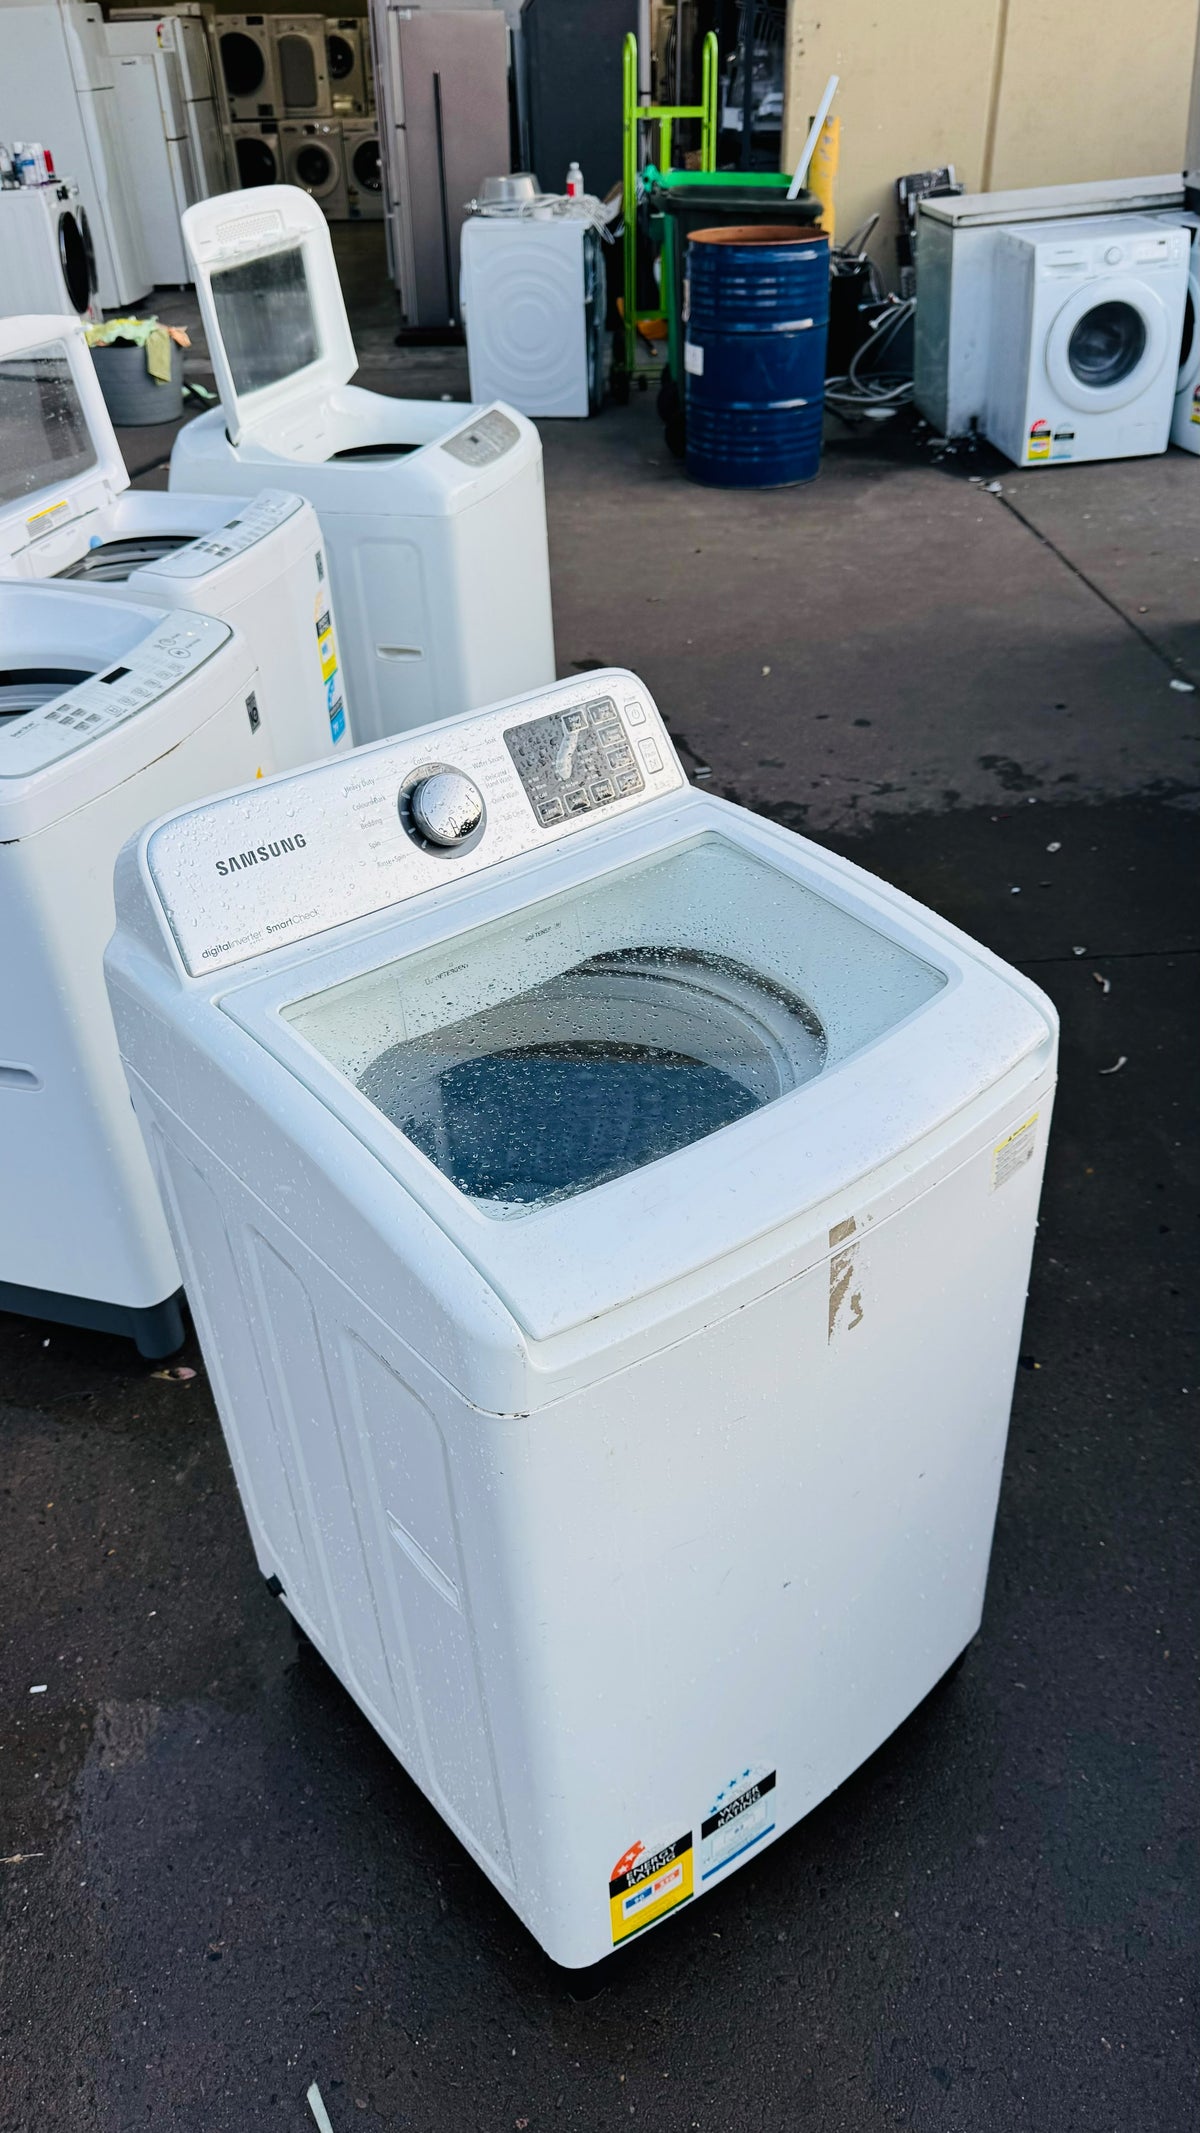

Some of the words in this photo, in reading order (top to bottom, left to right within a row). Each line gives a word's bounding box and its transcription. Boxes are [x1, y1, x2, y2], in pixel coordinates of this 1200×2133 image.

[360, 817, 383, 830] Bedding
[215, 833, 307, 876] SAMSUNG
[368, 840, 382, 850] Spin
[717, 1793, 761, 1828] RATING
[719, 1785, 760, 1817] WATER
[626, 1843, 677, 1881] ENERGY
[628, 1853, 676, 1888] RATING
